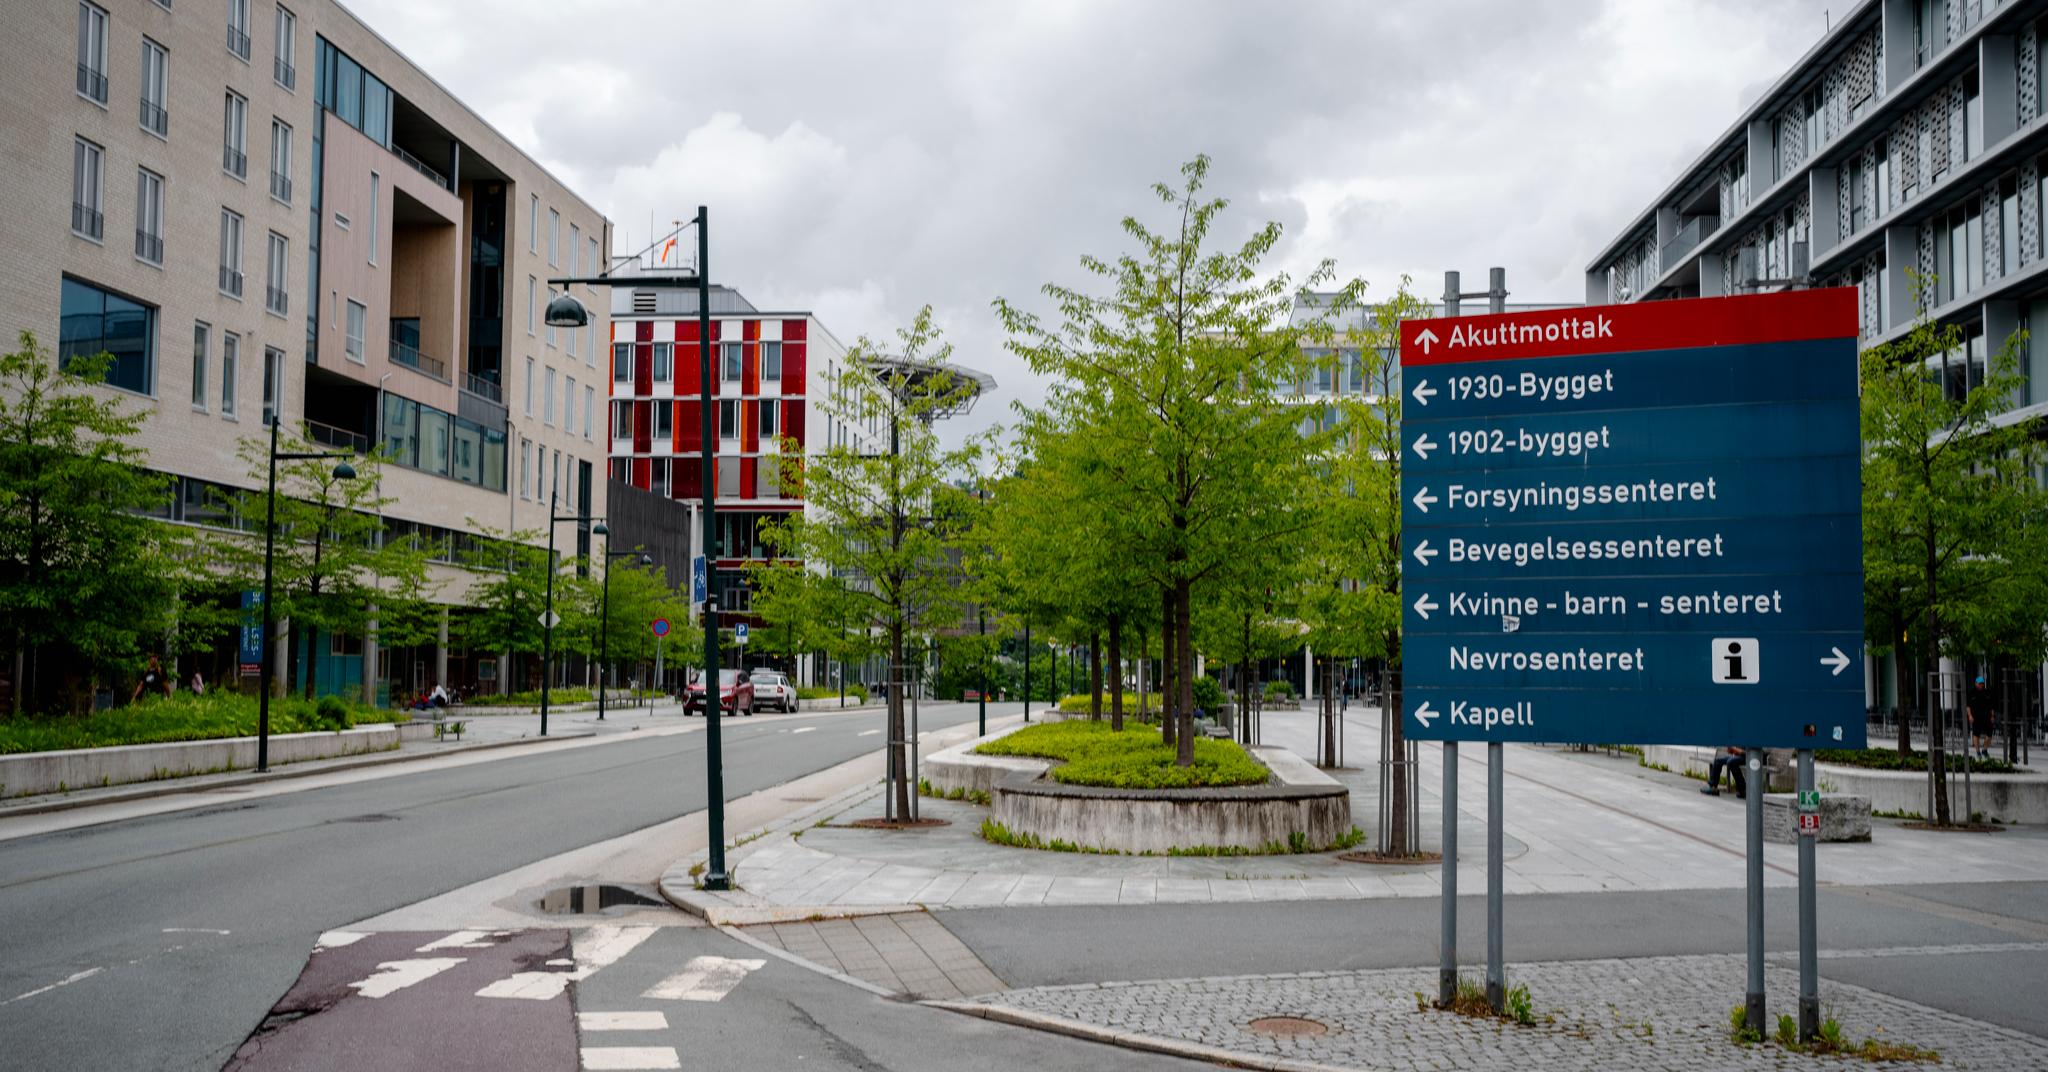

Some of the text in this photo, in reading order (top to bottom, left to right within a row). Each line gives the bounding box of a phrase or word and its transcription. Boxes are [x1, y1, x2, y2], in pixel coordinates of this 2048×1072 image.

[1448, 314, 1614, 349] Akuttmottak
[1448, 368, 1614, 402] 1930-Bygget
[1448, 425, 1610, 457] 1902-bygget
[1448, 476, 1717, 513] Forsyningssenteret
[1449, 533, 1723, 567] Bevegelsessenteret
[1449, 591, 1539, 616] Kvinne
[1565, 590, 1626, 615] barn
[1660, 589, 1782, 614] senteret
[738, 625, 746, 635] P
[1450, 646, 1644, 671] Nevrosenteret
[1450, 700, 1534, 731] Kapell
[1805, 791, 1815, 805] K
